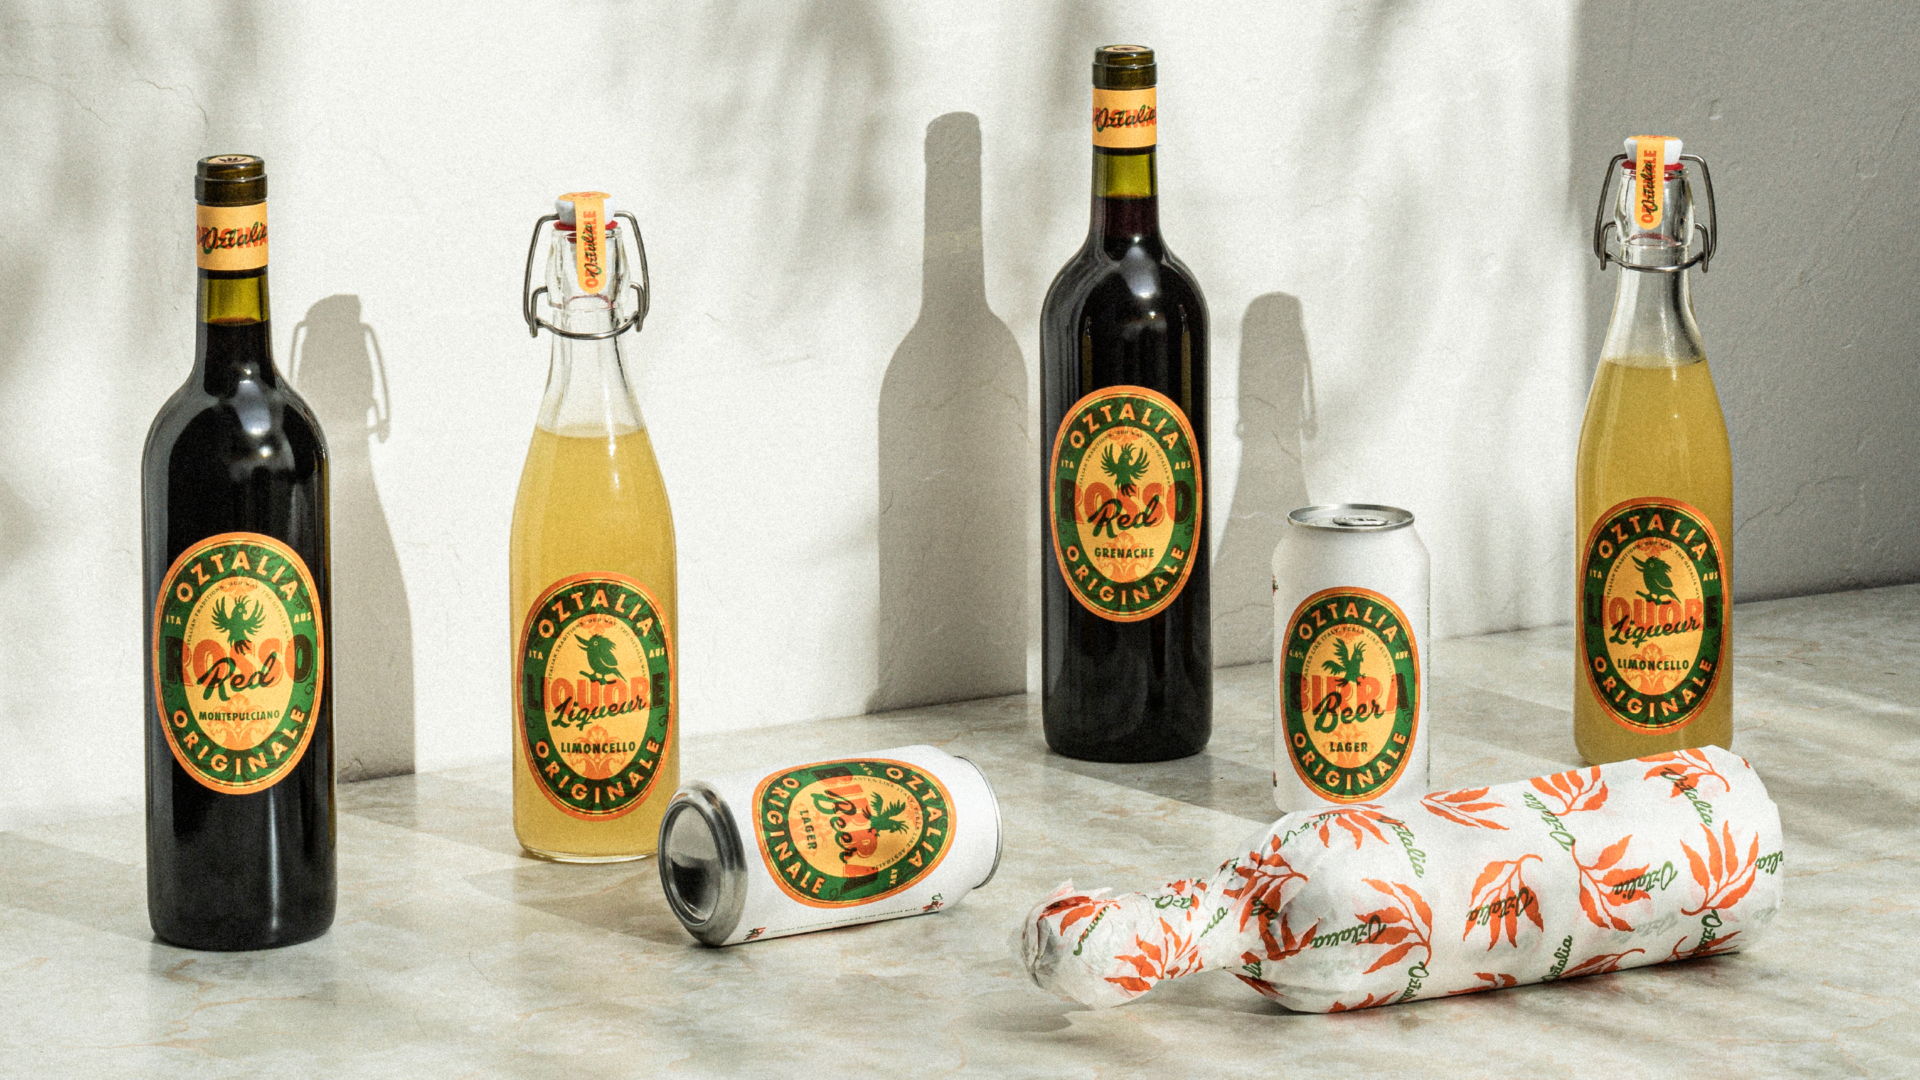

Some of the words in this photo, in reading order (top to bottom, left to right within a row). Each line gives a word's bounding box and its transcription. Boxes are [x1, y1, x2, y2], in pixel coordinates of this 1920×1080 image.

[1070, 403, 1179, 449] OZTALIA
[1061, 459, 1074, 469] ITA
[1175, 460, 1191, 470] AUS
[1060, 477, 1193, 527] ROSSO
[1086, 494, 1160, 538] Red
[1094, 547, 1154, 559] GRENACHE
[1598, 513, 1708, 562] OZTALIA
[177, 551, 301, 602] OZTALIA
[1067, 545, 1185, 605] ORIGINALE
[1589, 569, 1602, 579] ITA
[1703, 571, 1718, 581] AUS
[166, 614, 182, 625] ITA
[293, 611, 312, 623] AUS
[538, 589, 654, 638] OZTALIA
[1299, 602, 1398, 643] OZTALIA
[1586, 592, 1719, 634] LIQUORE
[1609, 614, 1700, 649] Liqueur
[165, 633, 314, 689] ROSSO
[529, 650, 543, 660] ITA
[649, 647, 665, 658] AUS
[1617, 658, 1689, 671] LIMONCELLO
[196, 652, 278, 701] Red
[527, 671, 666, 715] LIQUORE
[1289, 671, 1411, 715] BIRRA
[1594, 656, 1712, 718] ORIGINALE
[199, 709, 280, 722] MONTEPULCIANO
[551, 695, 647, 731] Liqueur
[1313, 691, 1386, 734] Beer
[173, 708, 306, 775] ORIGINALE
[561, 742, 636, 754] LIMONCELLO
[1294, 731, 1406, 790] ORIGINALE
[1329, 741, 1368, 753] LAGER
[535, 739, 660, 803] ORIGINALE
[886, 767, 943, 868] OZTALIA
[1660, 767, 1713, 826] Oztalia
[767, 777, 826, 894] ORIGINALE
[800, 810, 818, 850] LAGER
[810, 790, 857, 864] Beer
[811, 766, 879, 894] BIRRA
[1523, 791, 1576, 851] Oztalia
[1612, 861, 1678, 901] Oztalia
[1466, 887, 1533, 926] Oztalia
